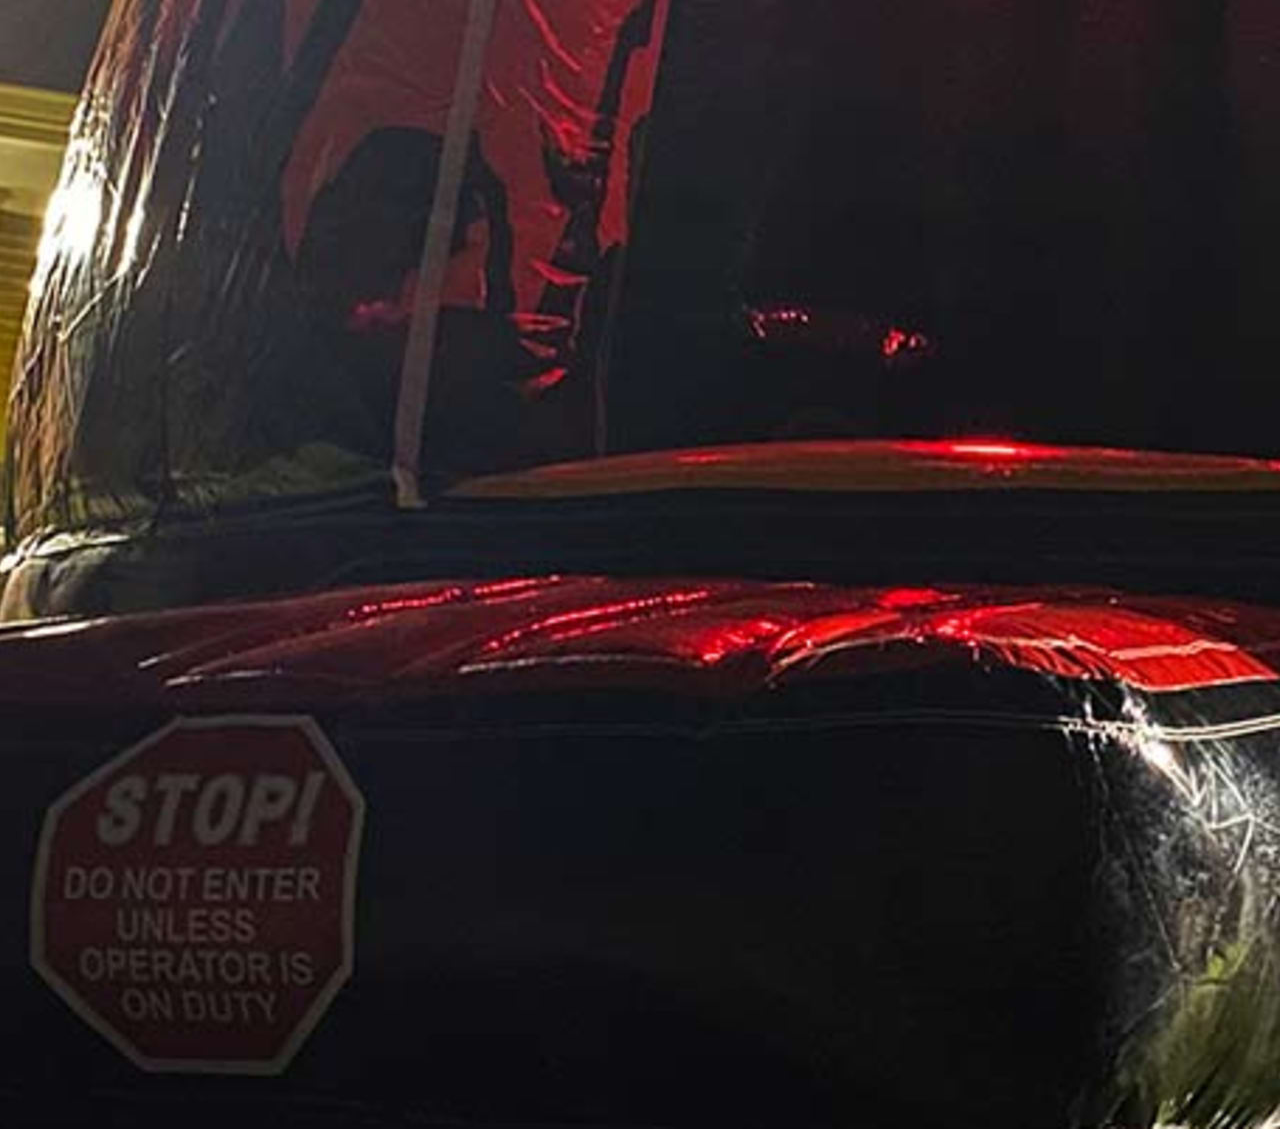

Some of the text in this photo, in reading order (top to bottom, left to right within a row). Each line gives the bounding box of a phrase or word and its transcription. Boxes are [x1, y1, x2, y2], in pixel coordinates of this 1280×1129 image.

[96, 772, 327, 847] STOP!
[64, 866, 320, 902] DO NOT ENTER
[117, 907, 257, 943] UNLESS
[79, 947, 316, 986] OPERATOR IS
[121, 987, 277, 1024] ON DUTY
